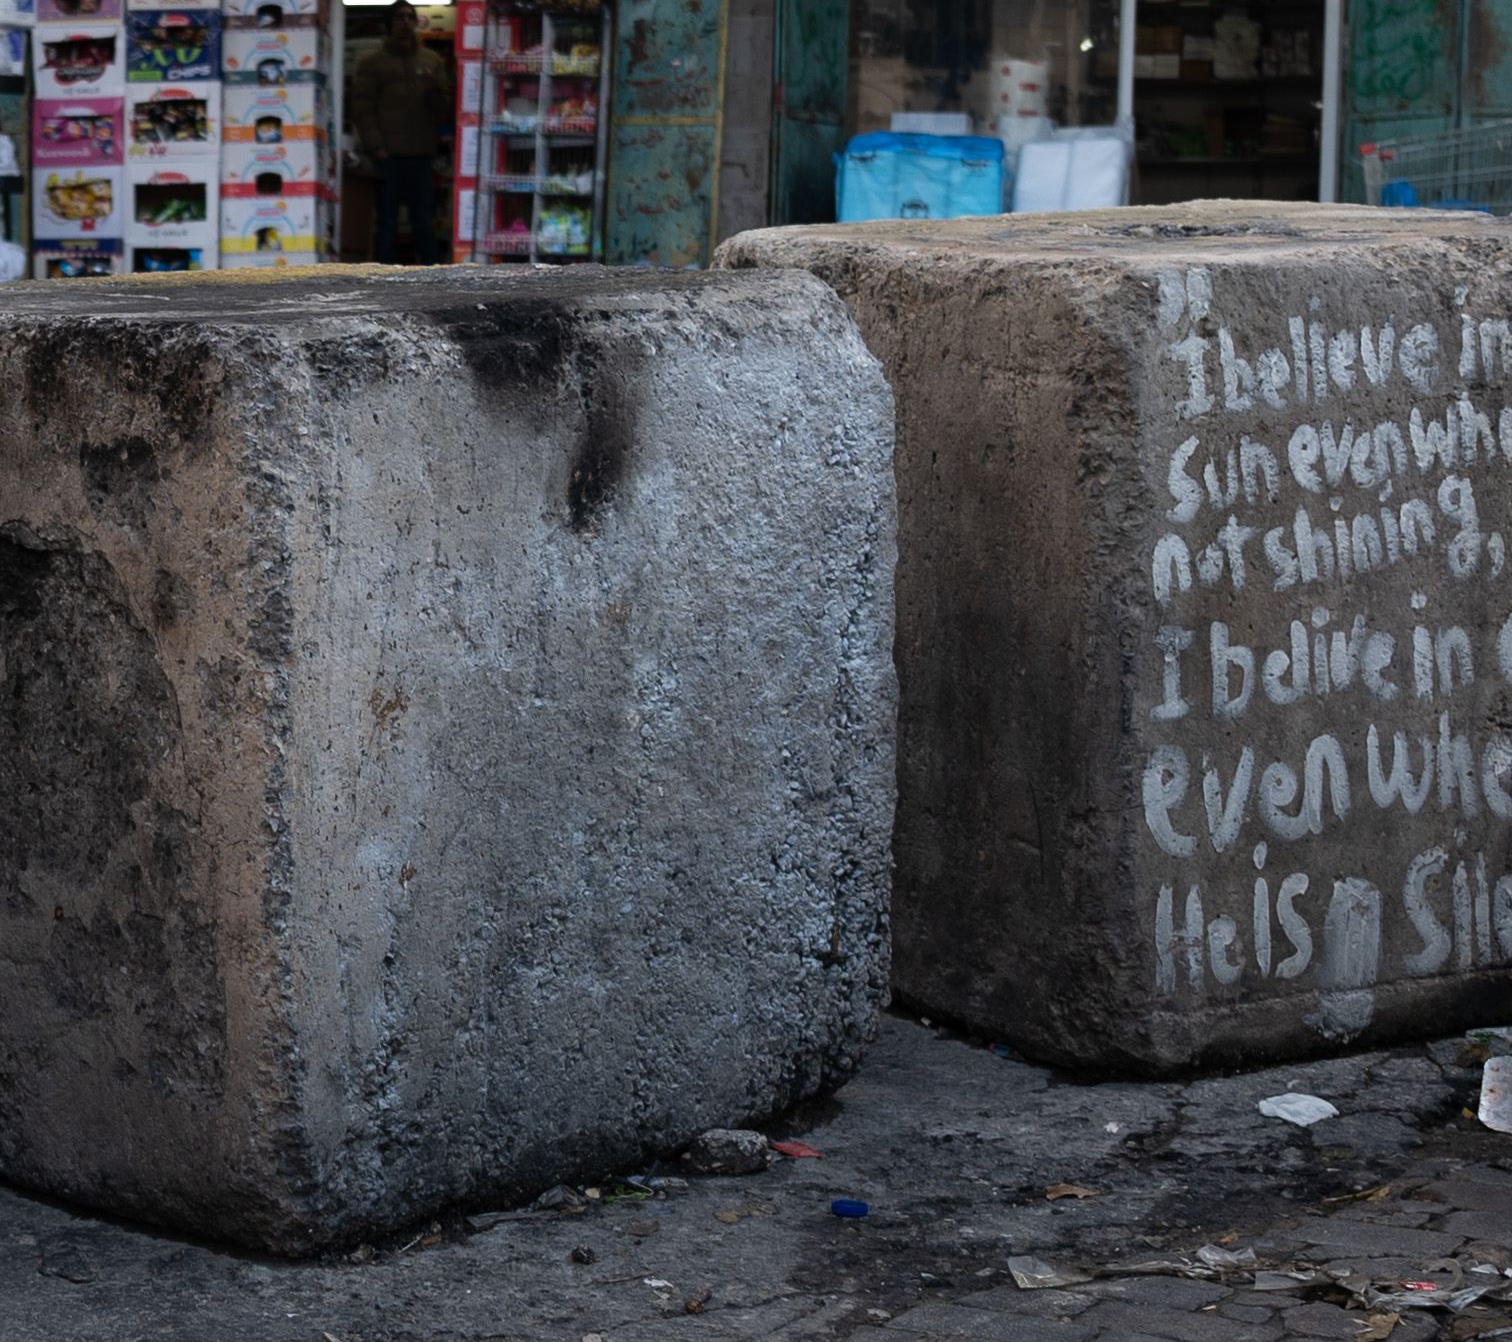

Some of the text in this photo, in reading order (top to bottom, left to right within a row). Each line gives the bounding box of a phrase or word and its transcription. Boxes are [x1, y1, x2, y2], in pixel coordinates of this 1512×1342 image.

[1149, 622, 1198, 722] I
[1411, 589, 1477, 703] in
[1142, 731, 1352, 861] even
[1155, 879, 1244, 994] He
[1252, 840, 1314, 980] is
